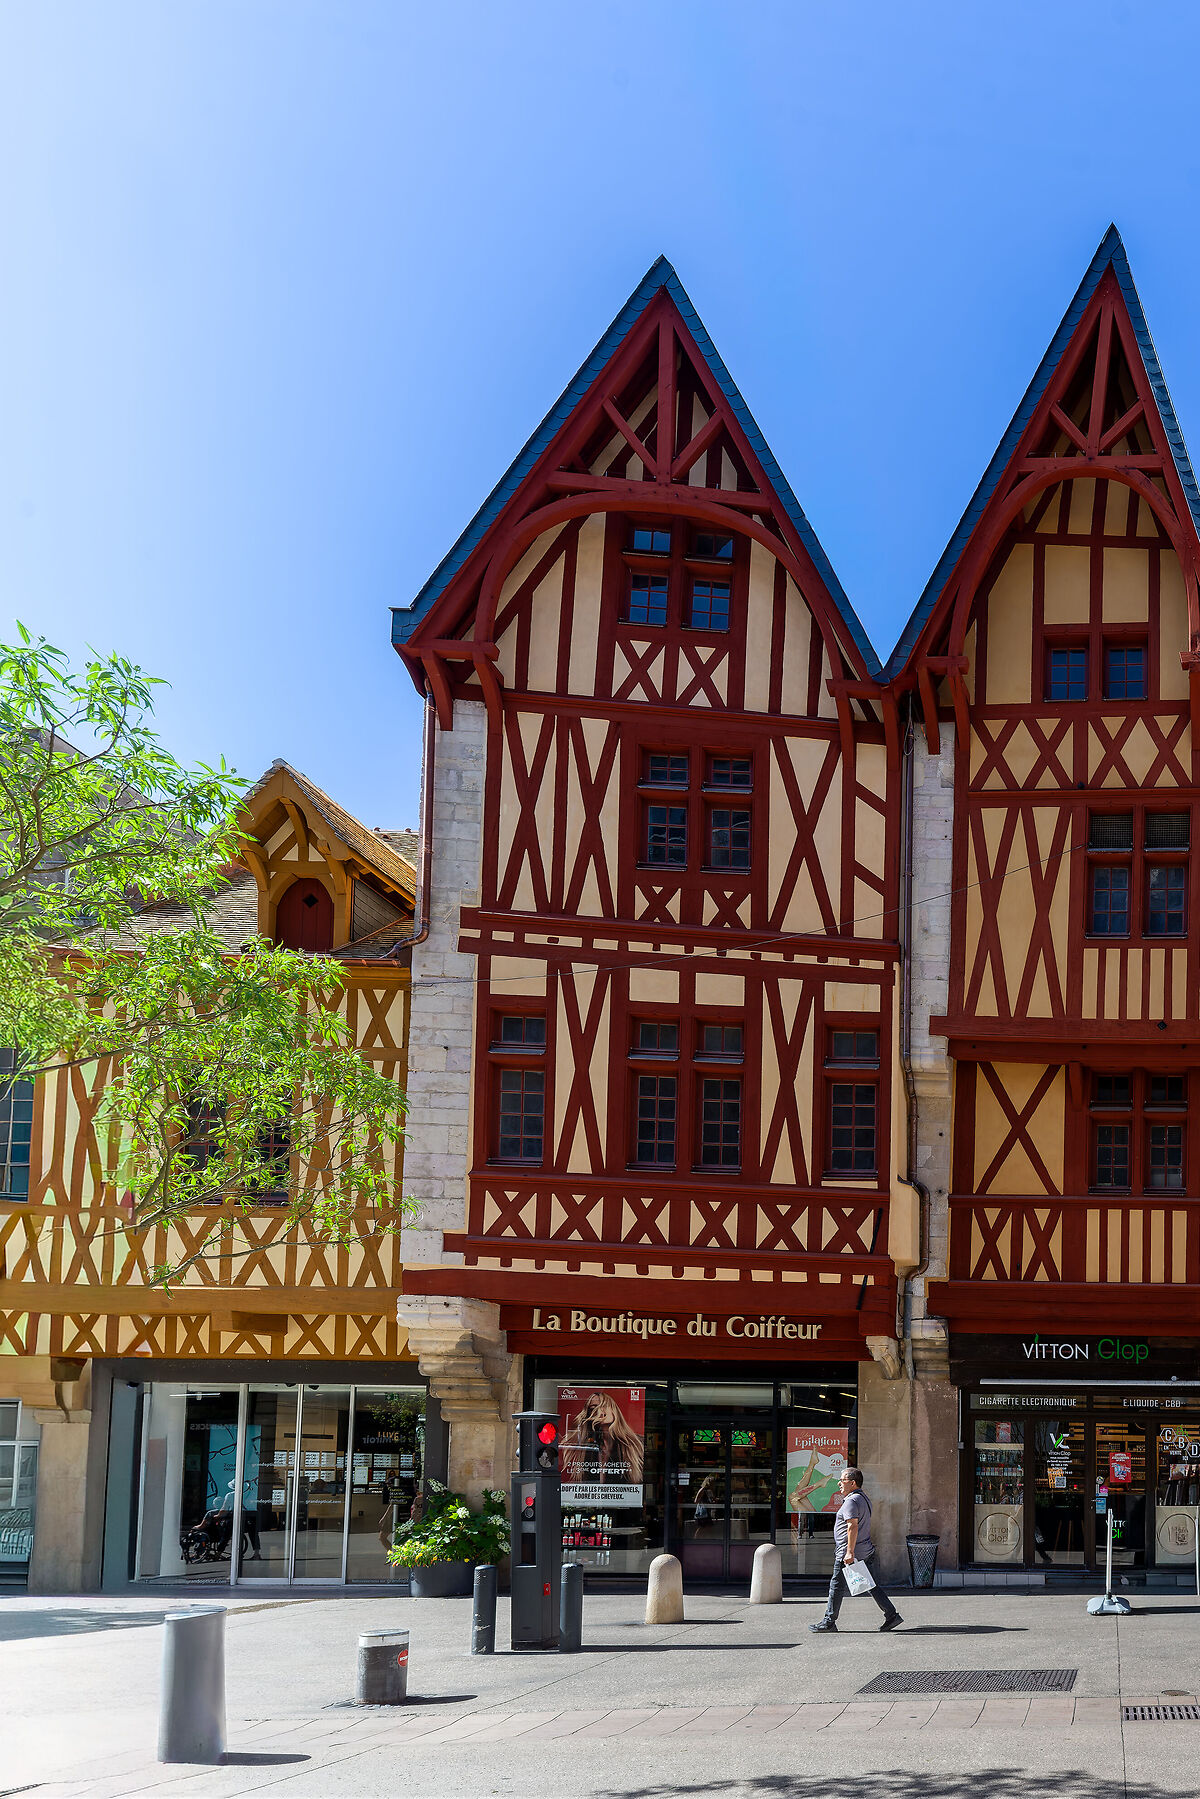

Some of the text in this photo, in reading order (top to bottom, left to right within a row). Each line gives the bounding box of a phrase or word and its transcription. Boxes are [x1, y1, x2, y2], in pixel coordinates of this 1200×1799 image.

[532, 1309, 822, 1340] La Boutique du Coiffeur
[1022, 1333, 1149, 1365] VITTON Clop
[979, 1396, 1077, 1407] CIGARETTE ELECTRONIQUE
[1123, 1399, 1159, 1408] E.LIQUIDE
[604, 1460, 632, 1468] ACHETÉS
[561, 1485, 578, 1493] DOPTÉ
